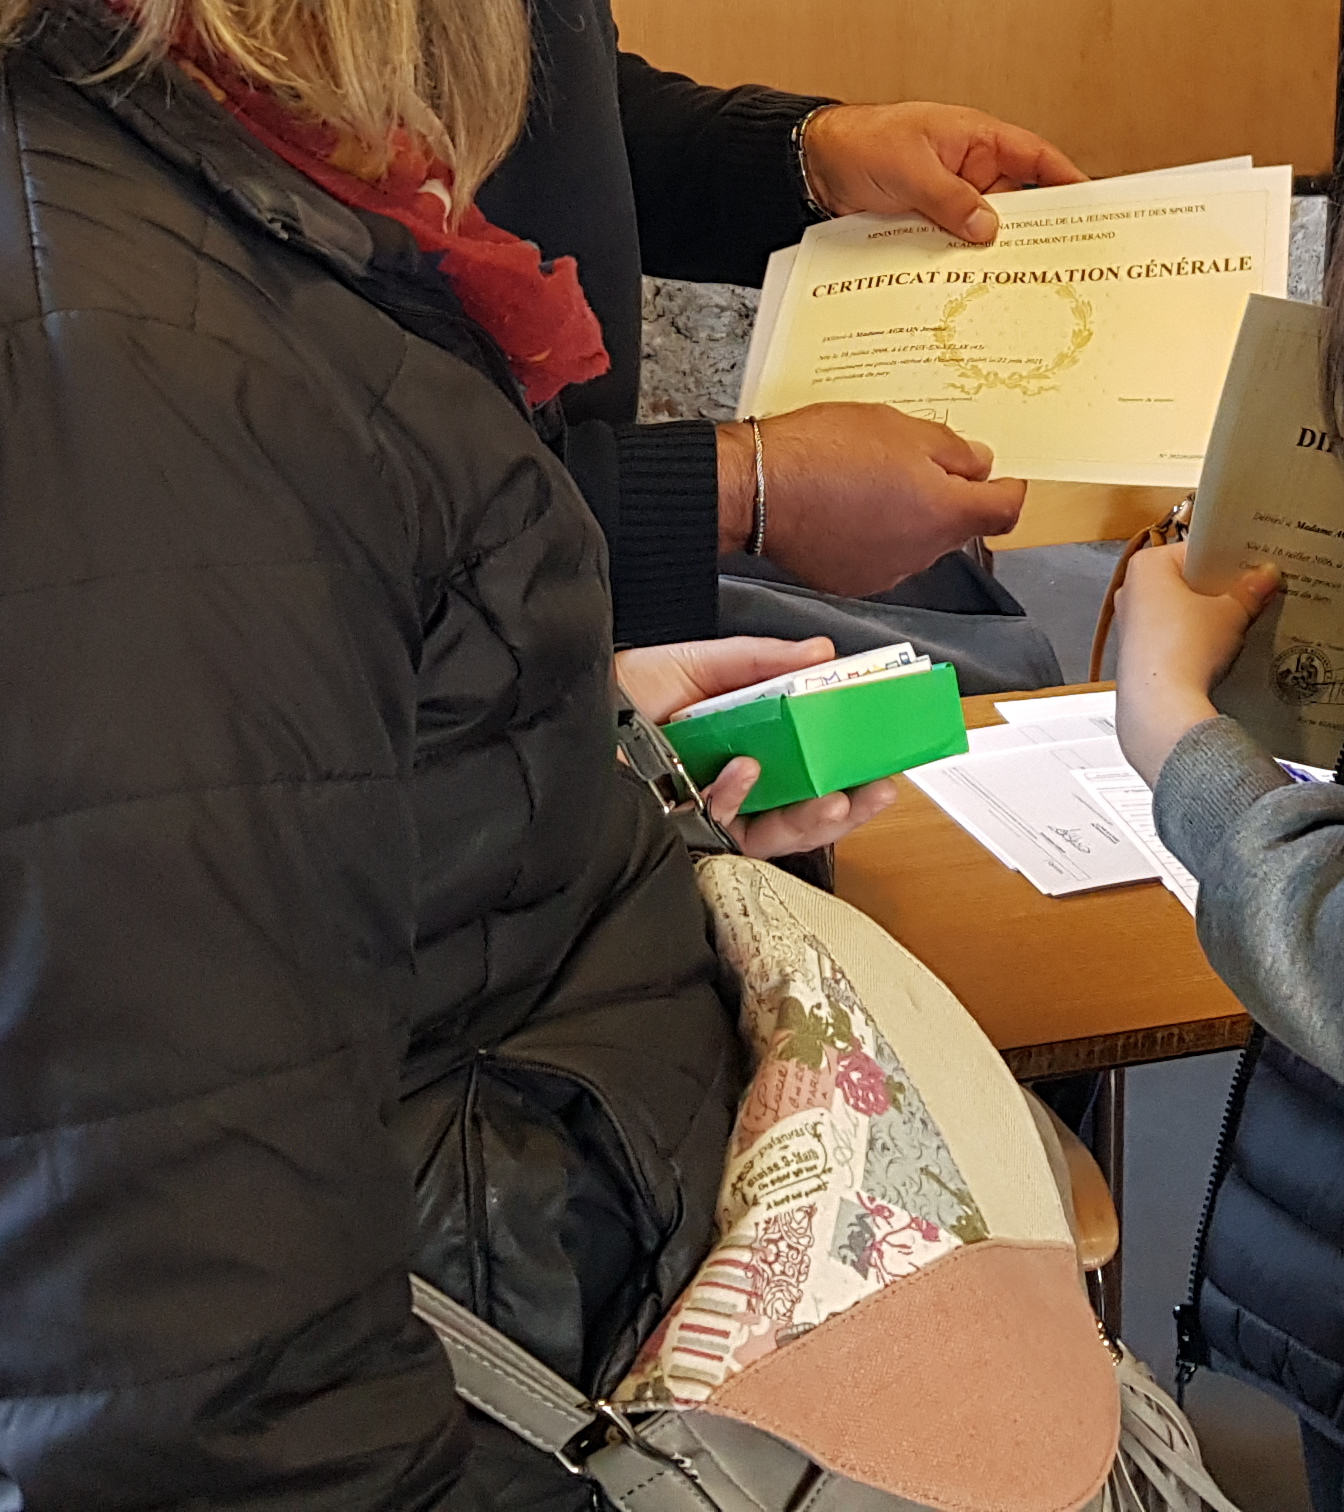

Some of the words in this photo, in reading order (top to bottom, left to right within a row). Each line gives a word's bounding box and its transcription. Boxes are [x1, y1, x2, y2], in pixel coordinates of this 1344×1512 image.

[1056, 217, 1069, 226] DE
[1070, 216, 1083, 224] LA
[1086, 212, 1131, 223] JEUNESSE
[1134, 210, 1146, 218] ET
[1148, 207, 1167, 217] DES
[1169, 204, 1206, 215] SPORTS
[999, 240, 1013, 248] DE
[1014, 231, 1116, 247] CLERMONT-FERRAND
[812, 271, 941, 298] CERTIFICAT
[946, 271, 976, 284] DE
[981, 266, 1121, 284] FORMATION
[1126, 256, 1253, 279] GÉNÉRALE
